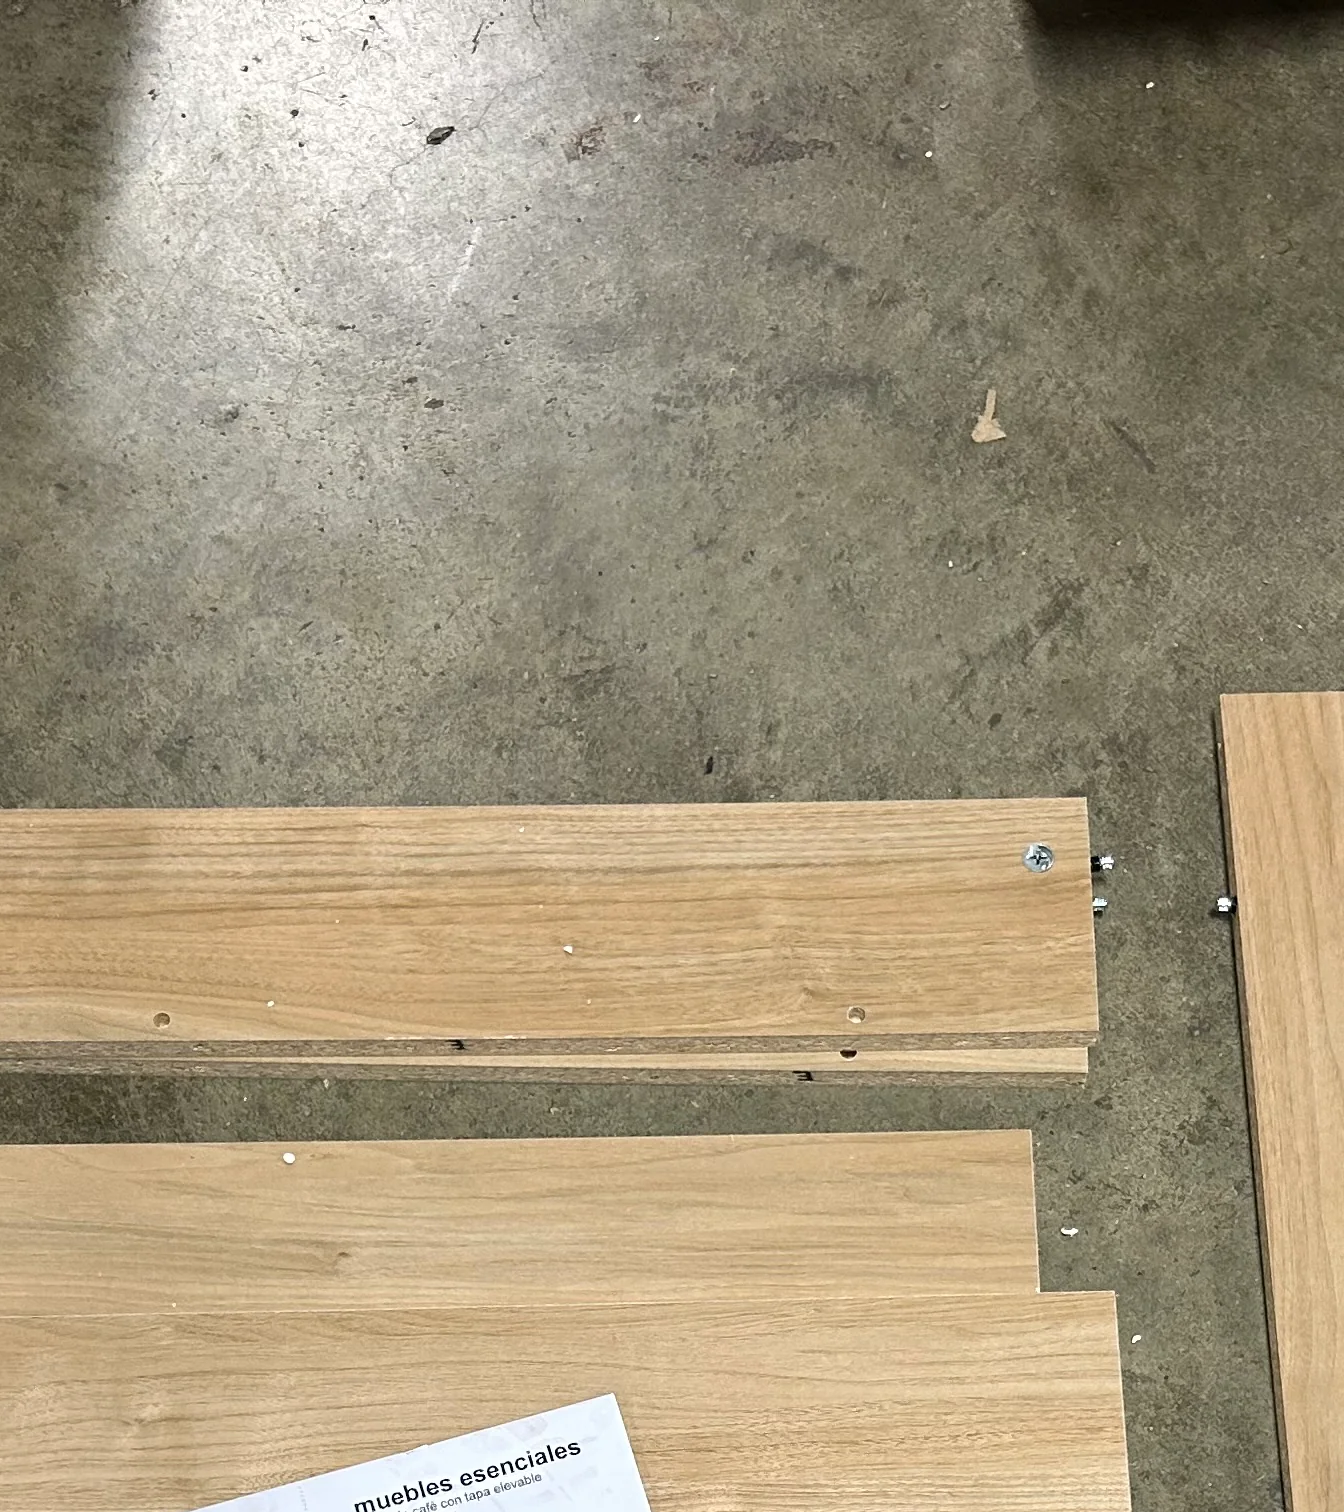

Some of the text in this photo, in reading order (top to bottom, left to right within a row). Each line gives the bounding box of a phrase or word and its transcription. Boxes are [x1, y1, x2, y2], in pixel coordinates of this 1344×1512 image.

[460, 1442, 581, 1486] esenciales
[441, 1495, 463, 1509] con
[465, 1488, 491, 1504] tapa
[494, 1473, 542, 1494] elevable
